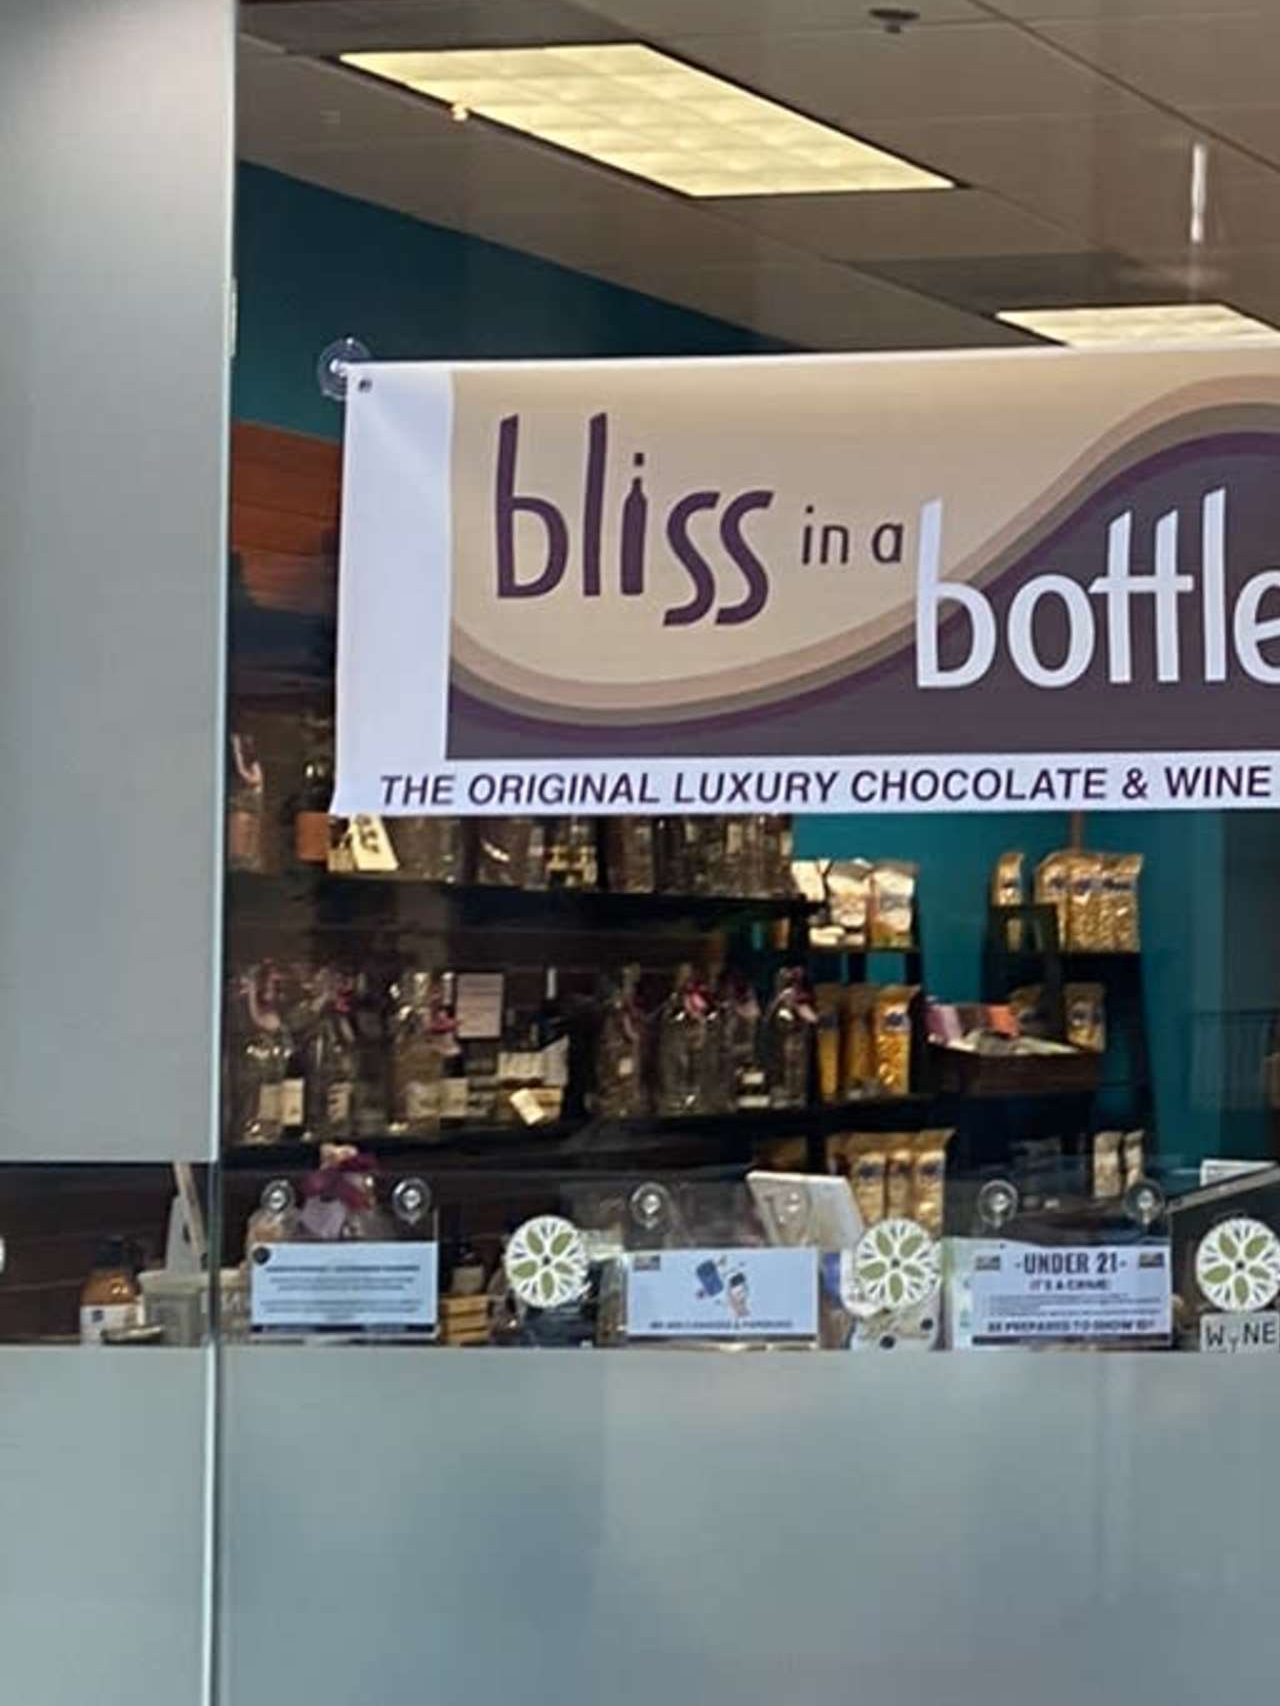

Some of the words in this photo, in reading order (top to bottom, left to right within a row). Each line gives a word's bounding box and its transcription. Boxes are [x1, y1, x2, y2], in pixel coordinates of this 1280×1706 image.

[496, 411, 775, 627] bliss
[801, 504, 851, 565] in
[870, 522, 905, 564] a
[380, 773, 455, 805] THE
[467, 771, 661, 805] ORIGINAL
[673, 769, 840, 804] LUXURY
[850, 766, 1108, 802] CHOCOLATE
[1120, 767, 1149, 800] &
[1164, 765, 1273, 799] WINE
